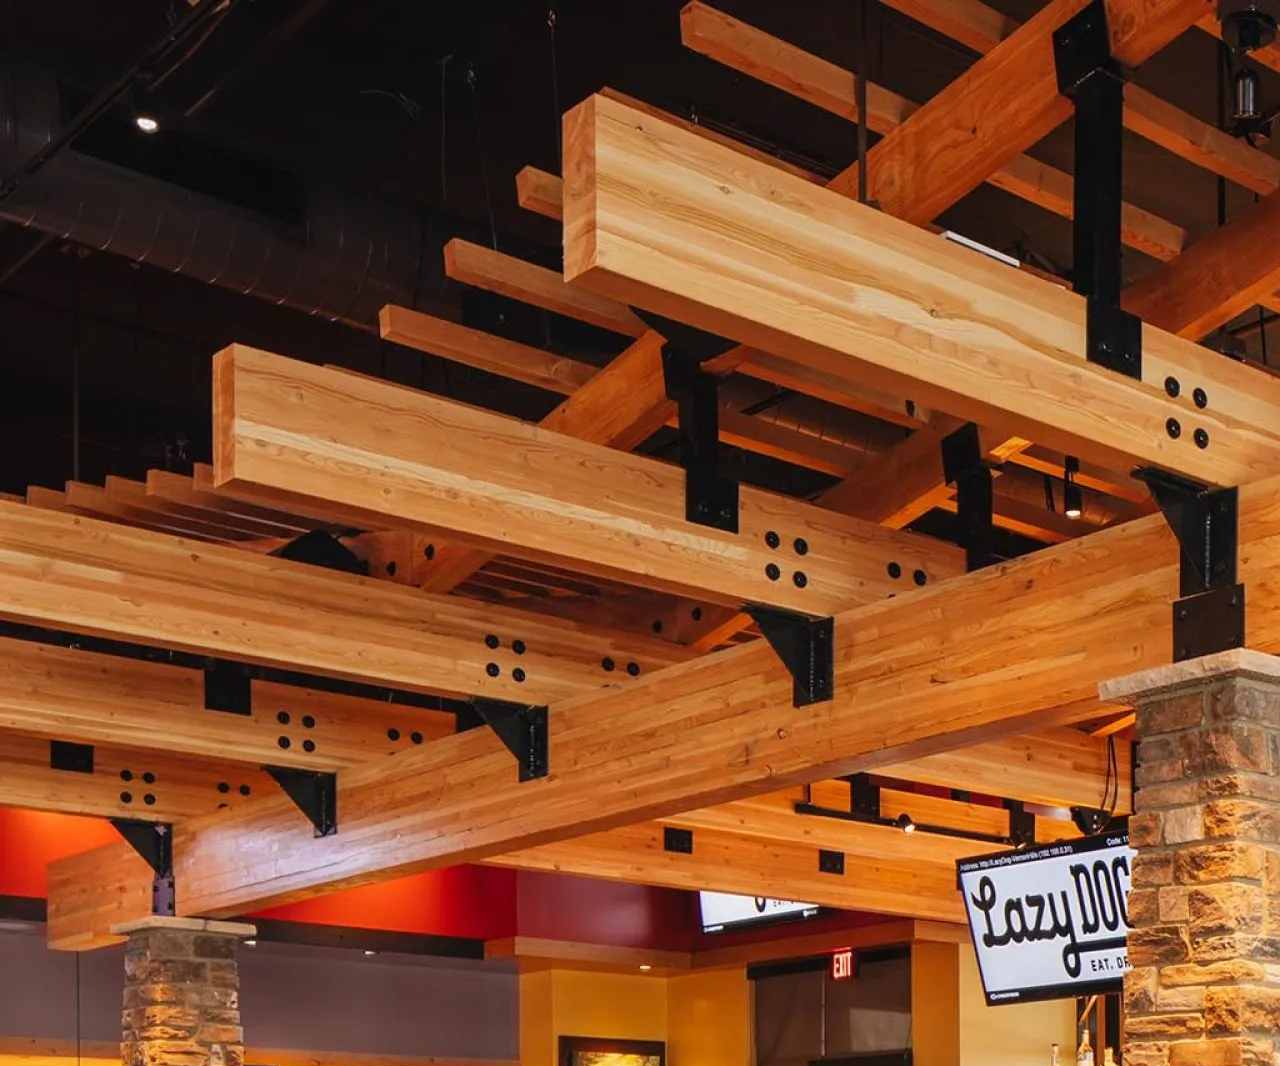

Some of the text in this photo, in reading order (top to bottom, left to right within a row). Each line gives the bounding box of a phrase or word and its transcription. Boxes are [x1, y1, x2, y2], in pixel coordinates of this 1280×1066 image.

[970, 856, 1132, 978] Lazy DOG
[833, 952, 852, 979] EXIT
[1091, 957, 1114, 973] EAT.
